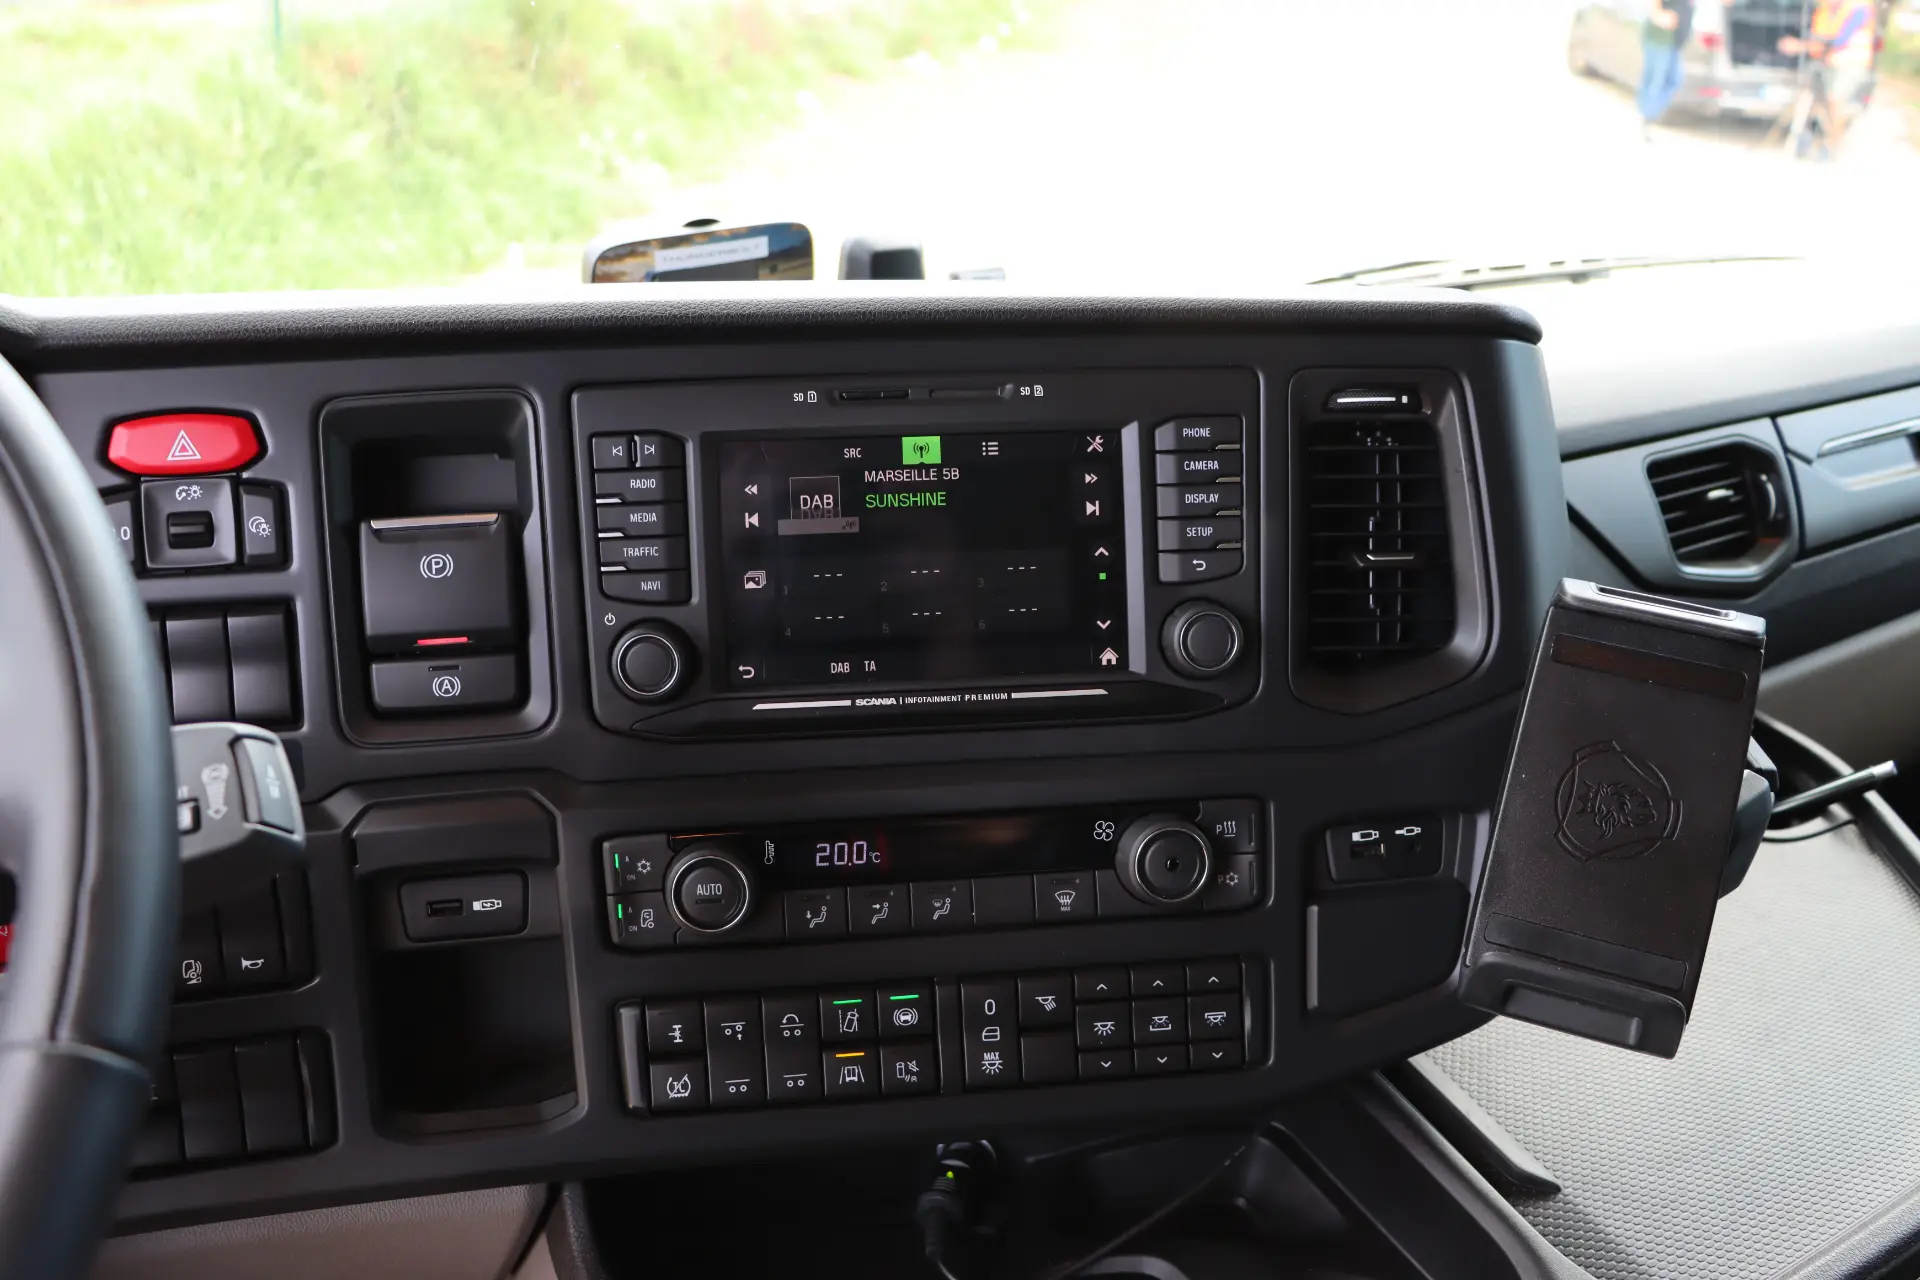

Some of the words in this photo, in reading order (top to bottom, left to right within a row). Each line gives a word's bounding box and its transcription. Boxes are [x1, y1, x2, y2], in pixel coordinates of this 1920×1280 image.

[1020, 386, 1031, 396] SD
[793, 392, 804, 402] SD
[1182, 427, 1211, 438] PHONE
[843, 447, 862, 459] SRC
[1183, 460, 1220, 471] CAMERA
[864, 468, 938, 483] MARSEILLE
[942, 467, 960, 480] 5B
[630, 478, 656, 489] RADIO
[800, 494, 834, 510] DAB
[865, 491, 947, 509] SUNSHINE
[1185, 493, 1219, 504] DISPLAY
[629, 512, 658, 523] MEDIA
[1186, 526, 1213, 537] SETUP
[622, 546, 659, 558] TRAFFIC
[641, 580, 661, 591] NAVI
[880, 580, 888, 592] 2
[977, 577, 985, 588] 3
[882, 622, 890, 634] 5
[978, 619, 986, 630] 6
[785, 627, 792, 637] 4
[830, 662, 850, 674] DAB
[863, 660, 877, 672] TA
[855, 697, 898, 707] SCANIA
[905, 694, 962, 704] INFOTAINMENT
[964, 692, 1008, 702] PREMIUM
[1216, 824, 1223, 835] P
[815, 840, 868, 867] 20.0
[1217, 874, 1224, 885] P
[696, 883, 723, 896] AUTO
[983, 1052, 1000, 1060] MAX
